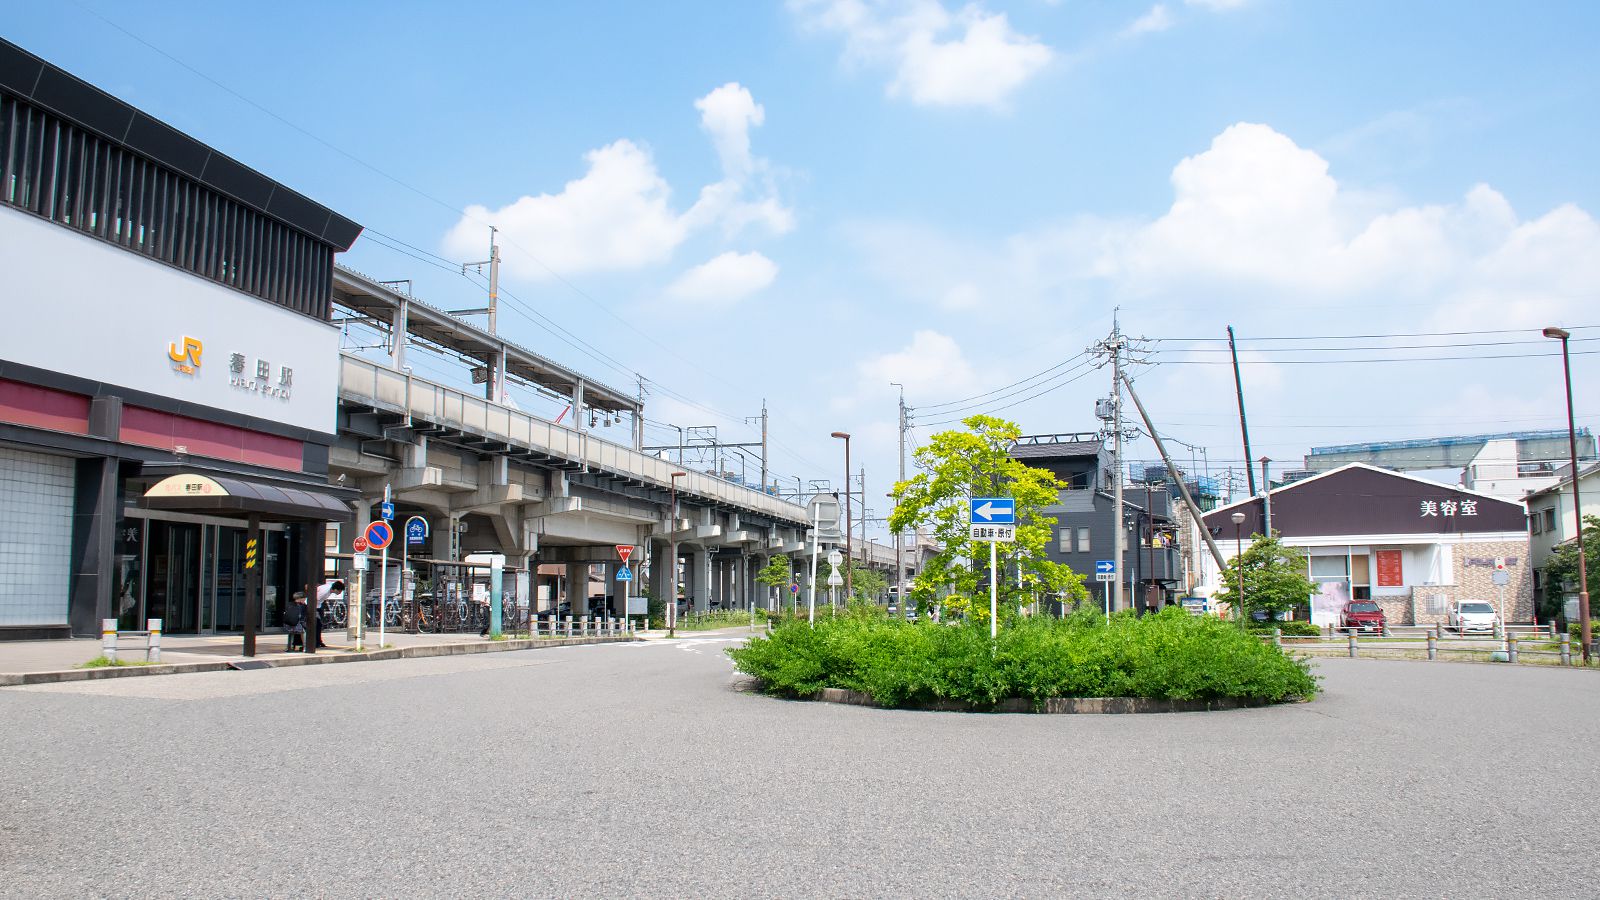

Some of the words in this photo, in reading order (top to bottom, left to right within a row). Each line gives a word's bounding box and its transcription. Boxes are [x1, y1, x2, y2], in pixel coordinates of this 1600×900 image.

[168, 335, 203, 368] JR
[229, 351, 293, 387] 春田駅
[185, 483, 203, 492] 春田駅
[1420, 499, 1479, 518] 美容室
